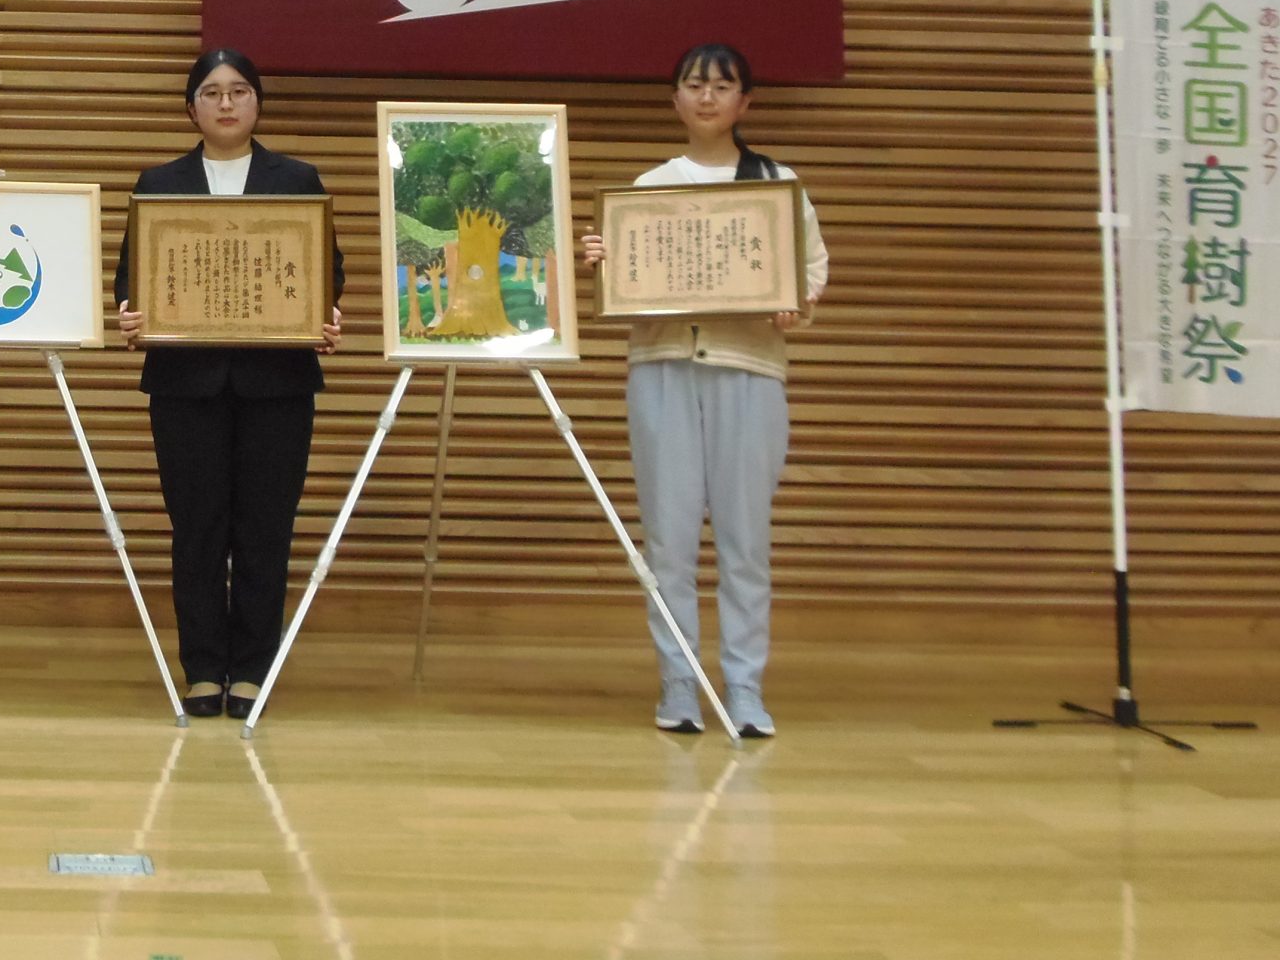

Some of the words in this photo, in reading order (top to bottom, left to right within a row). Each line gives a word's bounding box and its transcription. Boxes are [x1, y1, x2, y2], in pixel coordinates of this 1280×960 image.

[1181, 2, 1251, 384] 全国育樹祭
